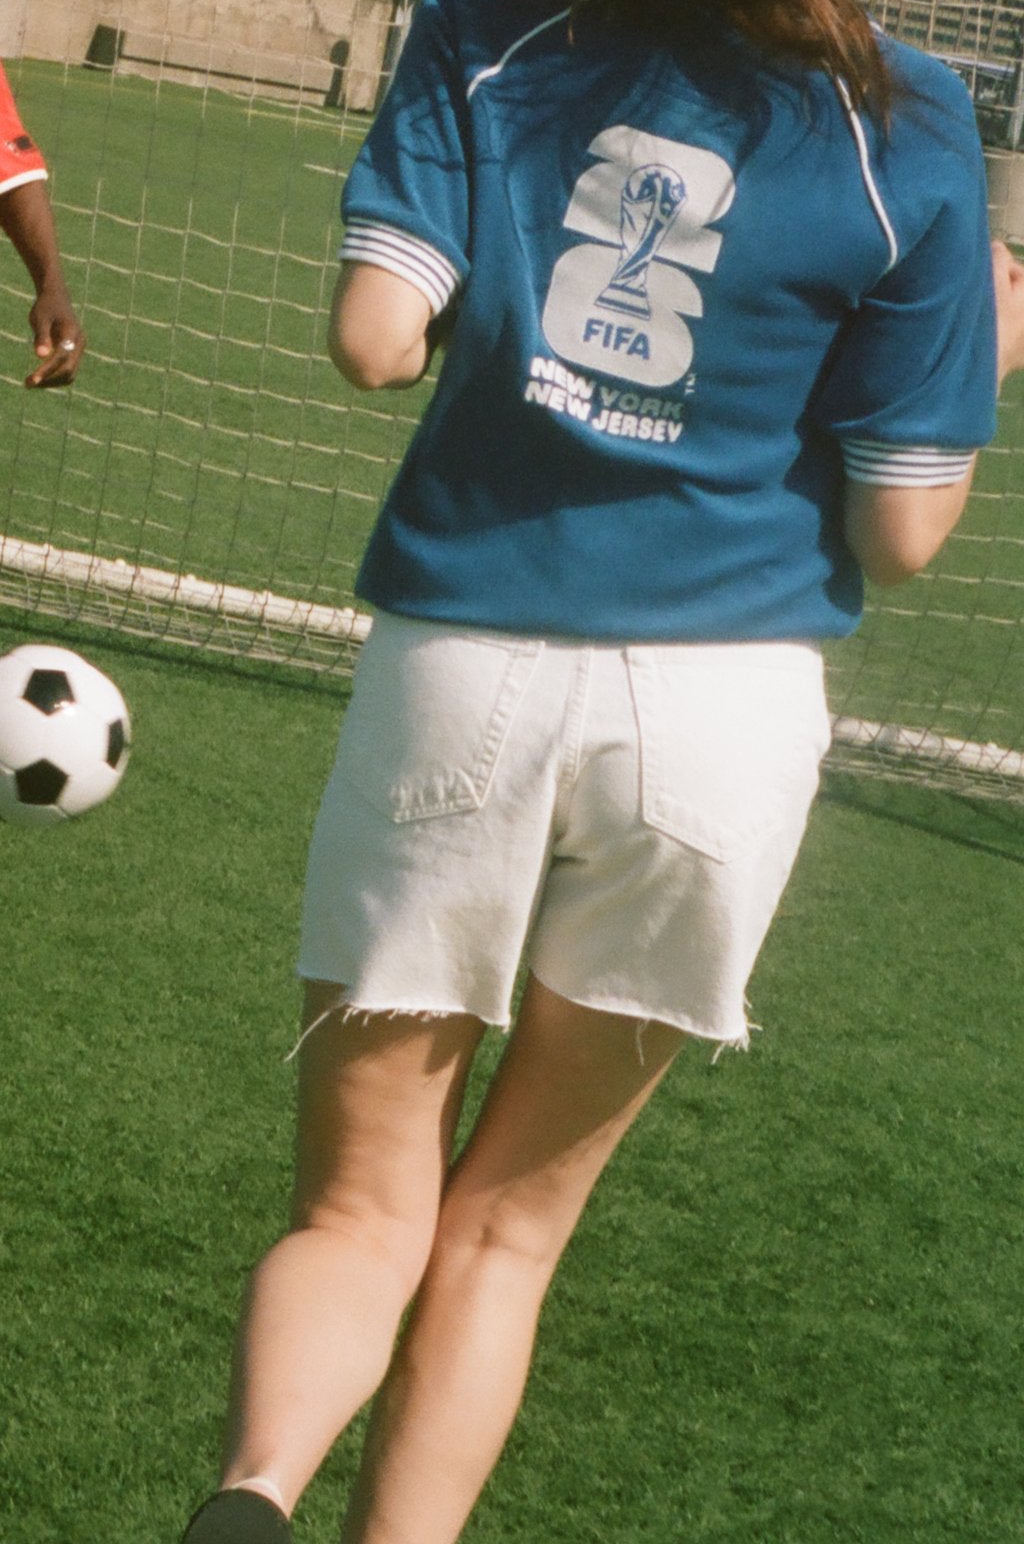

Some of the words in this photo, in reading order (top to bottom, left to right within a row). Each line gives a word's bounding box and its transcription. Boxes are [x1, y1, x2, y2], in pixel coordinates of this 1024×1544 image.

[582, 318, 650, 360] FIFA
[525, 380, 592, 421] NEW
[591, 409, 683, 443] JERSEY
[530, 357, 596, 399] NEW
[600, 386, 684, 419] YORK
